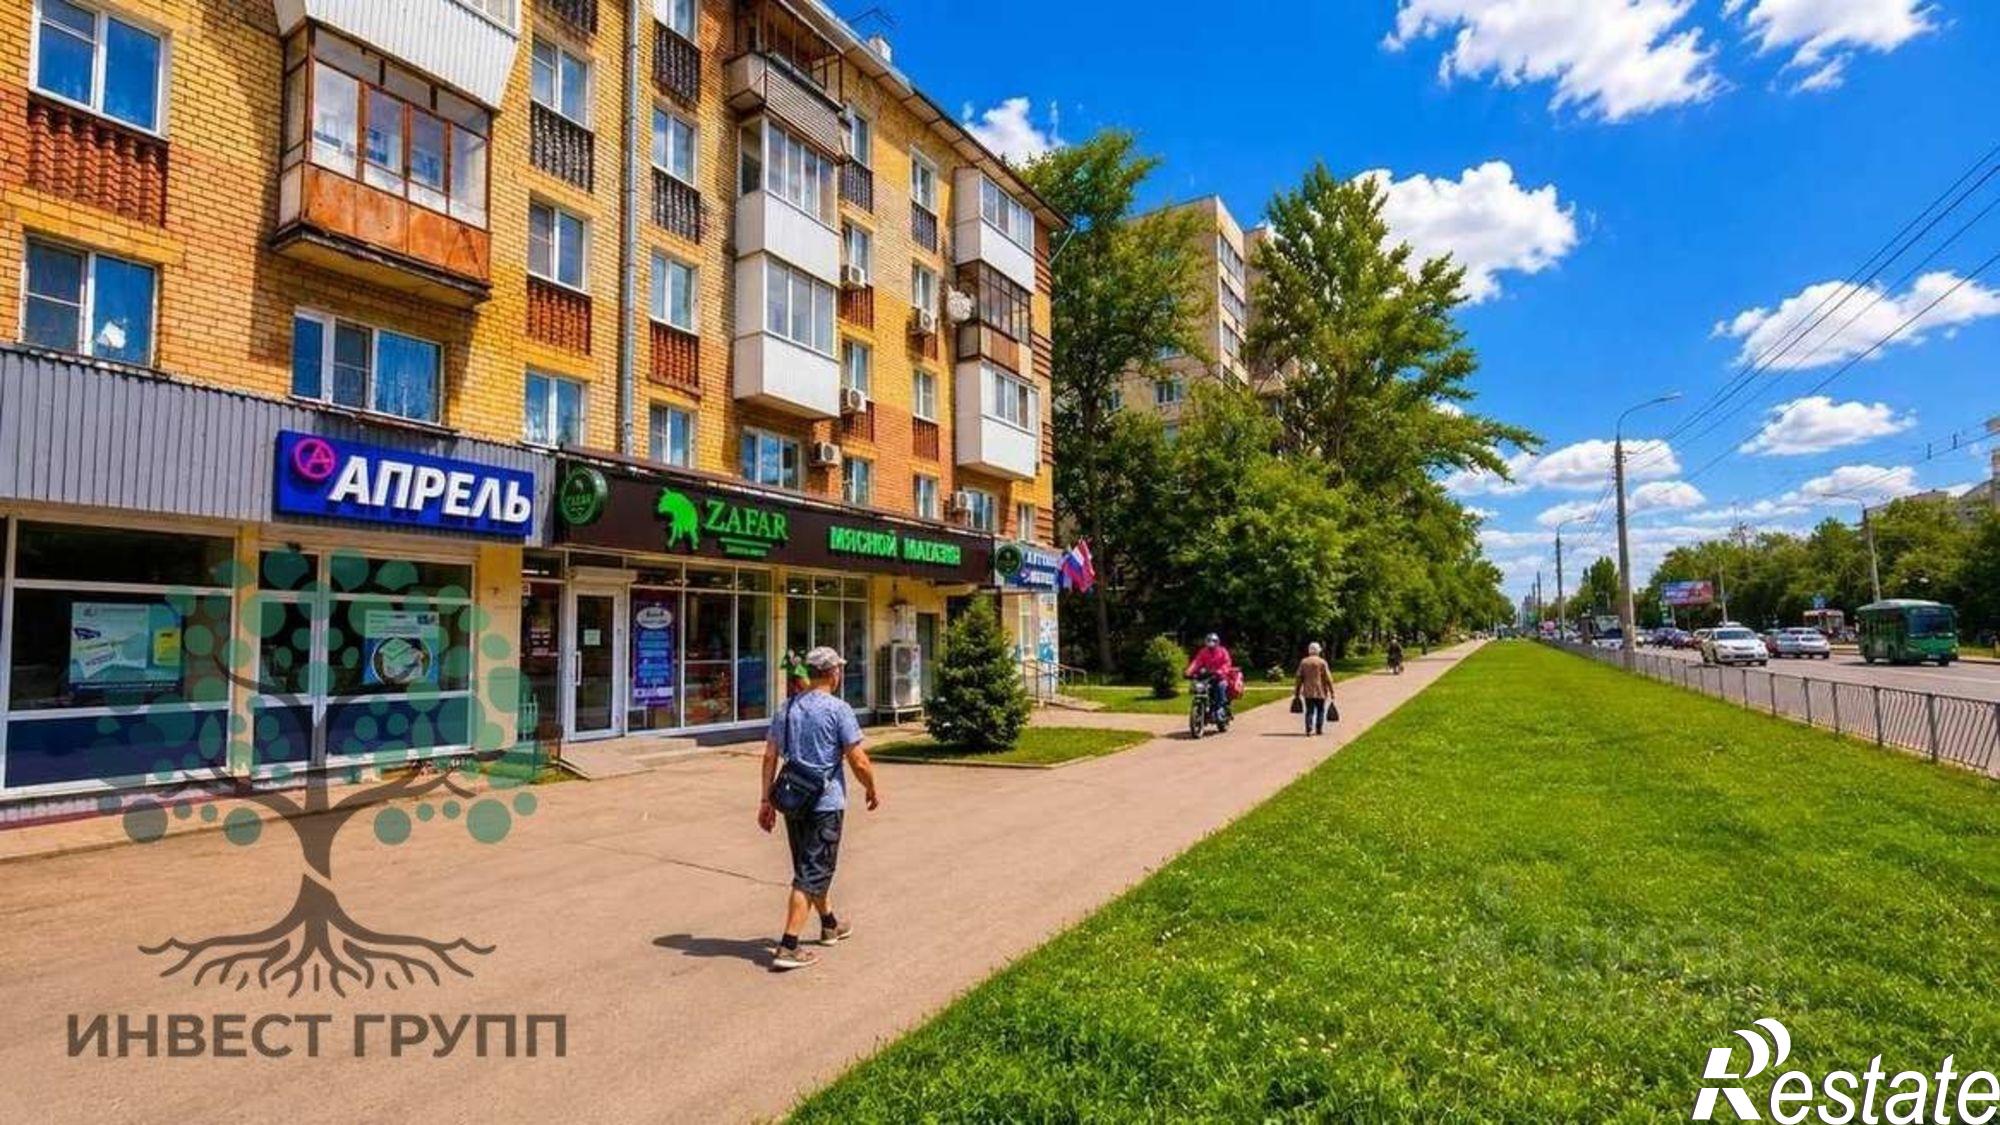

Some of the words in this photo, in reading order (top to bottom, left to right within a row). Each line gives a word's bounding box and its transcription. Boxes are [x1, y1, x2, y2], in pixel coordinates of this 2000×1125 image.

[327, 455, 531, 523] АПРЕЛЬ
[705, 499, 789, 540] ZAFAR
[830, 525, 898, 557] МЯСНОЙ
[903, 538, 961, 565] МАГАЗИН
